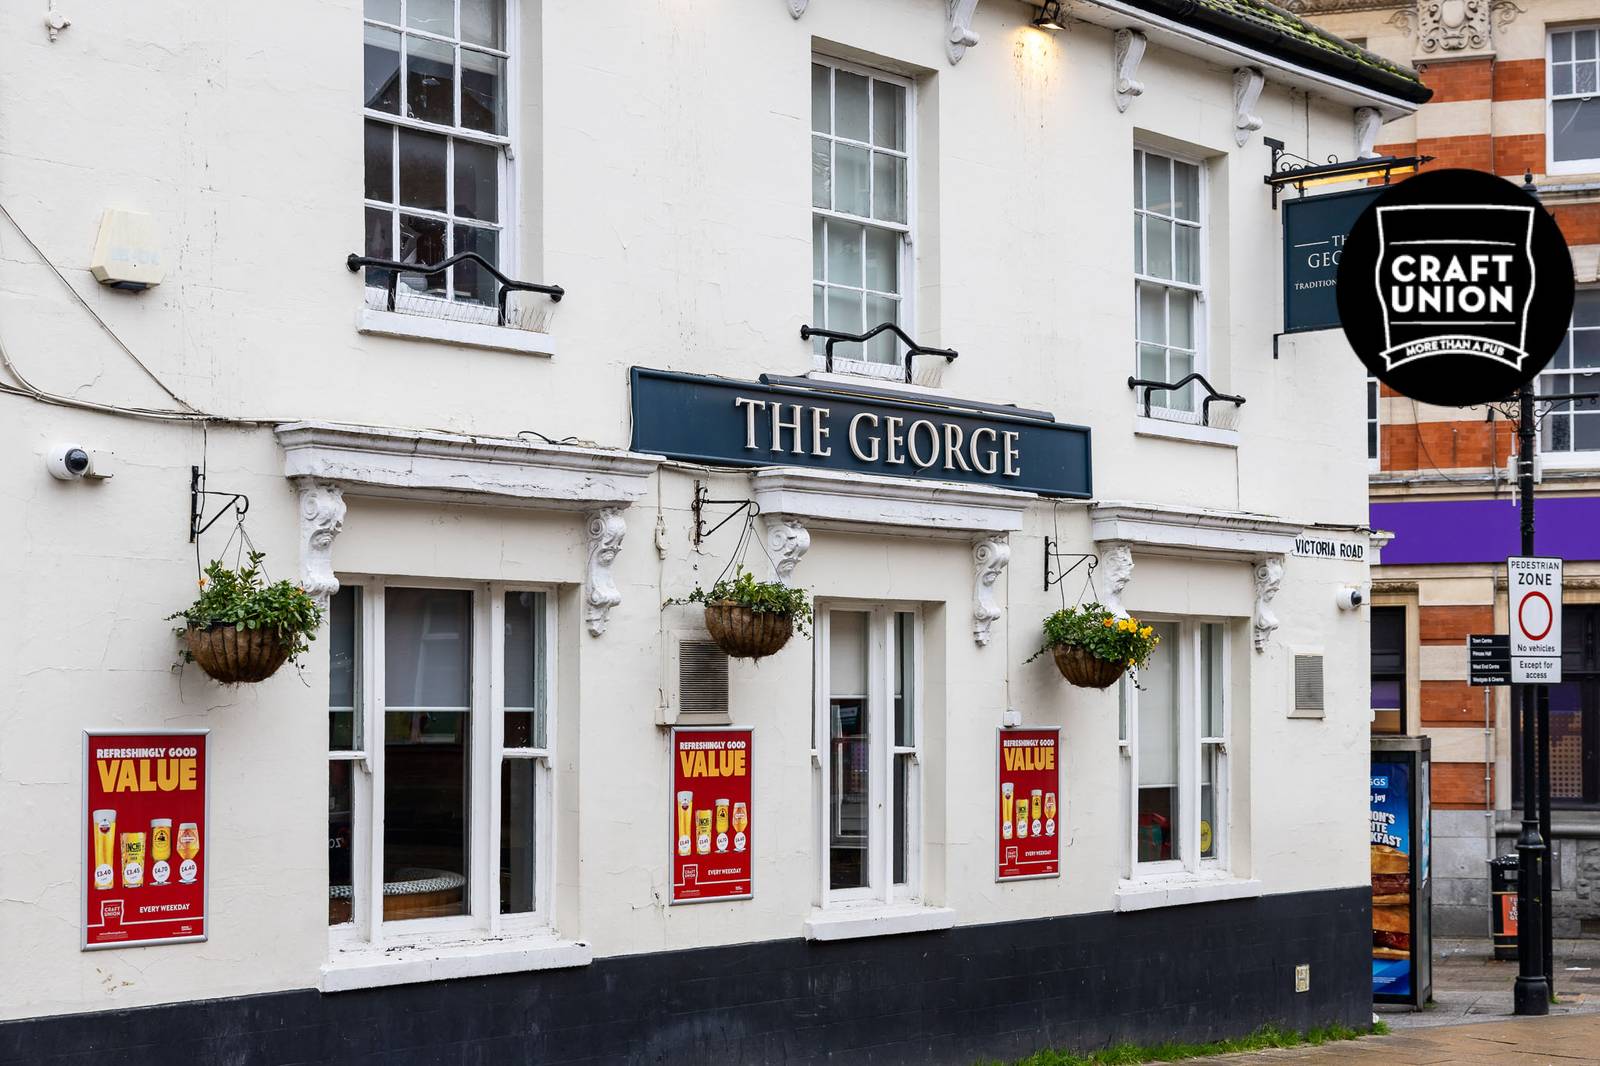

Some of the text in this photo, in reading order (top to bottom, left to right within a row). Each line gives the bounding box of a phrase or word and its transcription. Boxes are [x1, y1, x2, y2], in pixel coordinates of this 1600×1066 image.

[735, 396, 1021, 476] THE GEORGE
[1295, 538, 1364, 559] VICTORIA ROAD
[1511, 560, 1560, 570] PEDESTRIAN
[1518, 572, 1552, 586] ZONE
[1517, 643, 1555, 653] No vehicles
[1520, 660, 1553, 671] Except for
[1526, 671, 1547, 679] access
[680, 741, 746, 750] REFRESHINGLY GOOD
[1040, 739, 1055, 747] GOOD
[96, 747, 197, 759] REFRESHINGLY GOOD
[680, 750, 746, 778] VALUE
[1003, 747, 1055, 771] VALUE
[97, 758, 197, 793] VALUE
[1374, 793, 1386, 803] joy
[139, 903, 191, 914] EVERY WEEKDAY
